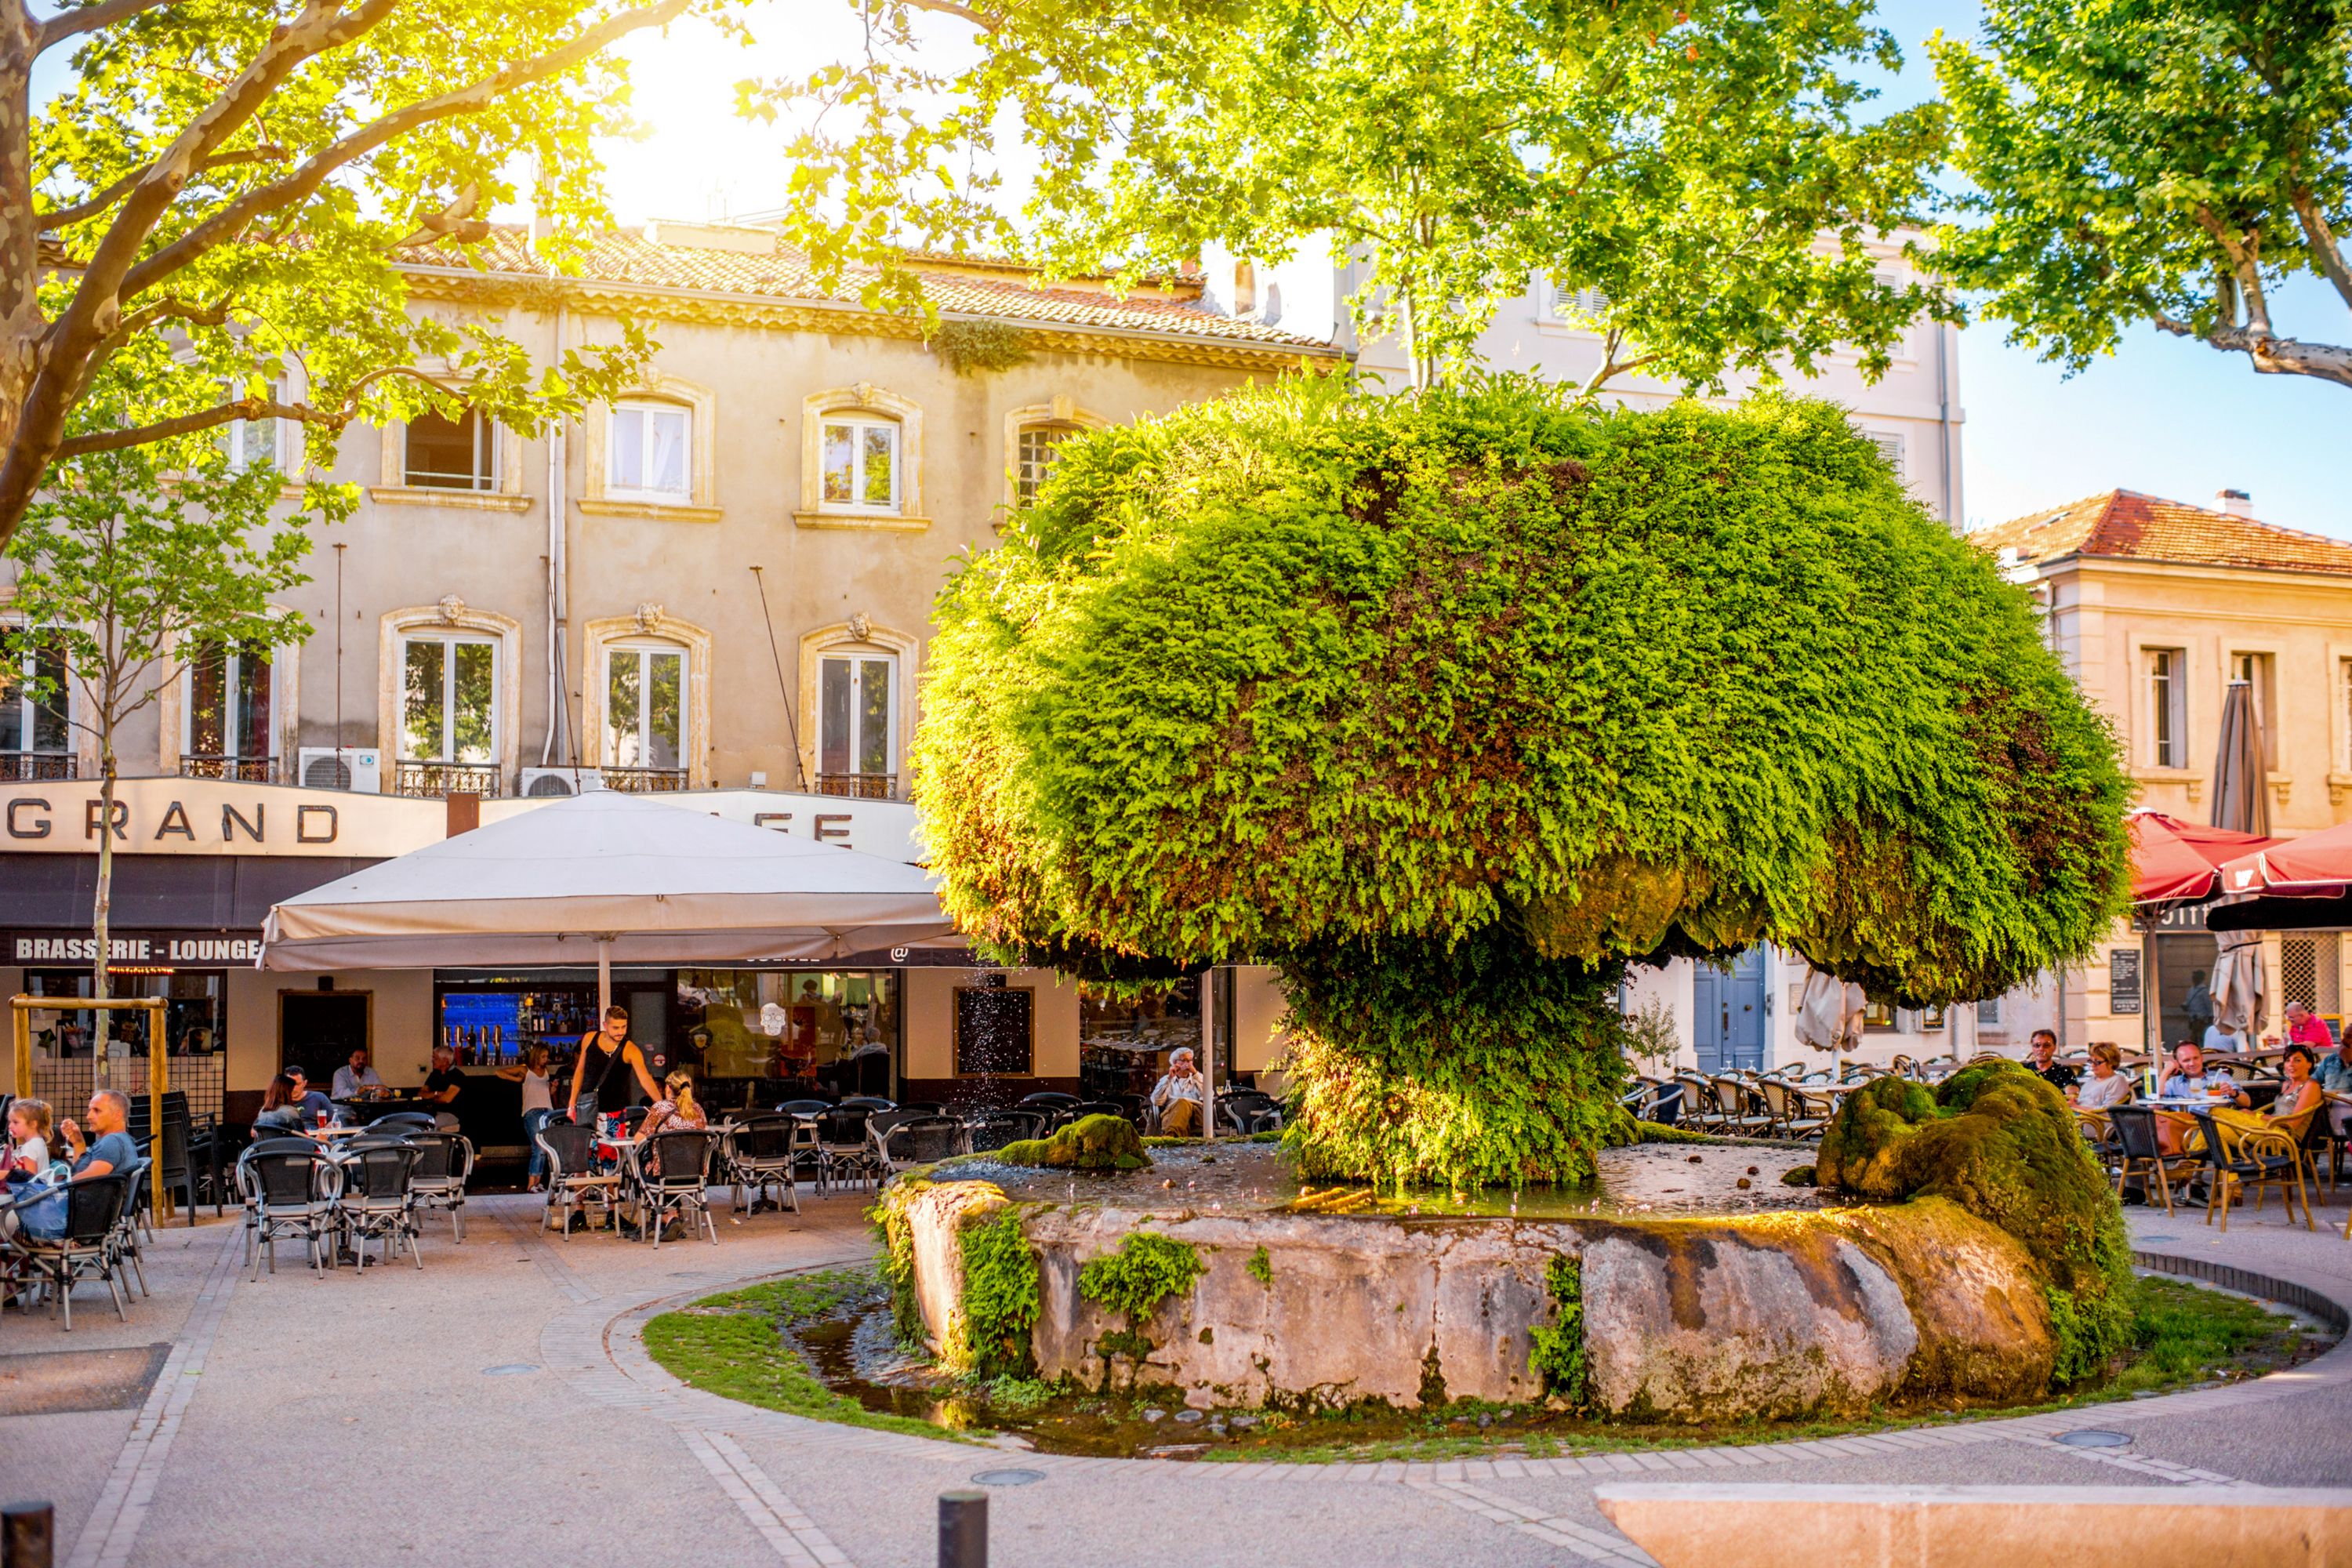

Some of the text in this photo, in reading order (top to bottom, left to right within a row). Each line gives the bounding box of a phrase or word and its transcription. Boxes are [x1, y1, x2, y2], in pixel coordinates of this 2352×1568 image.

[7, 797, 338, 844] GRAND
[16, 938, 150, 960] BRASSRIE
[169, 939, 260, 960] LOUNGE
